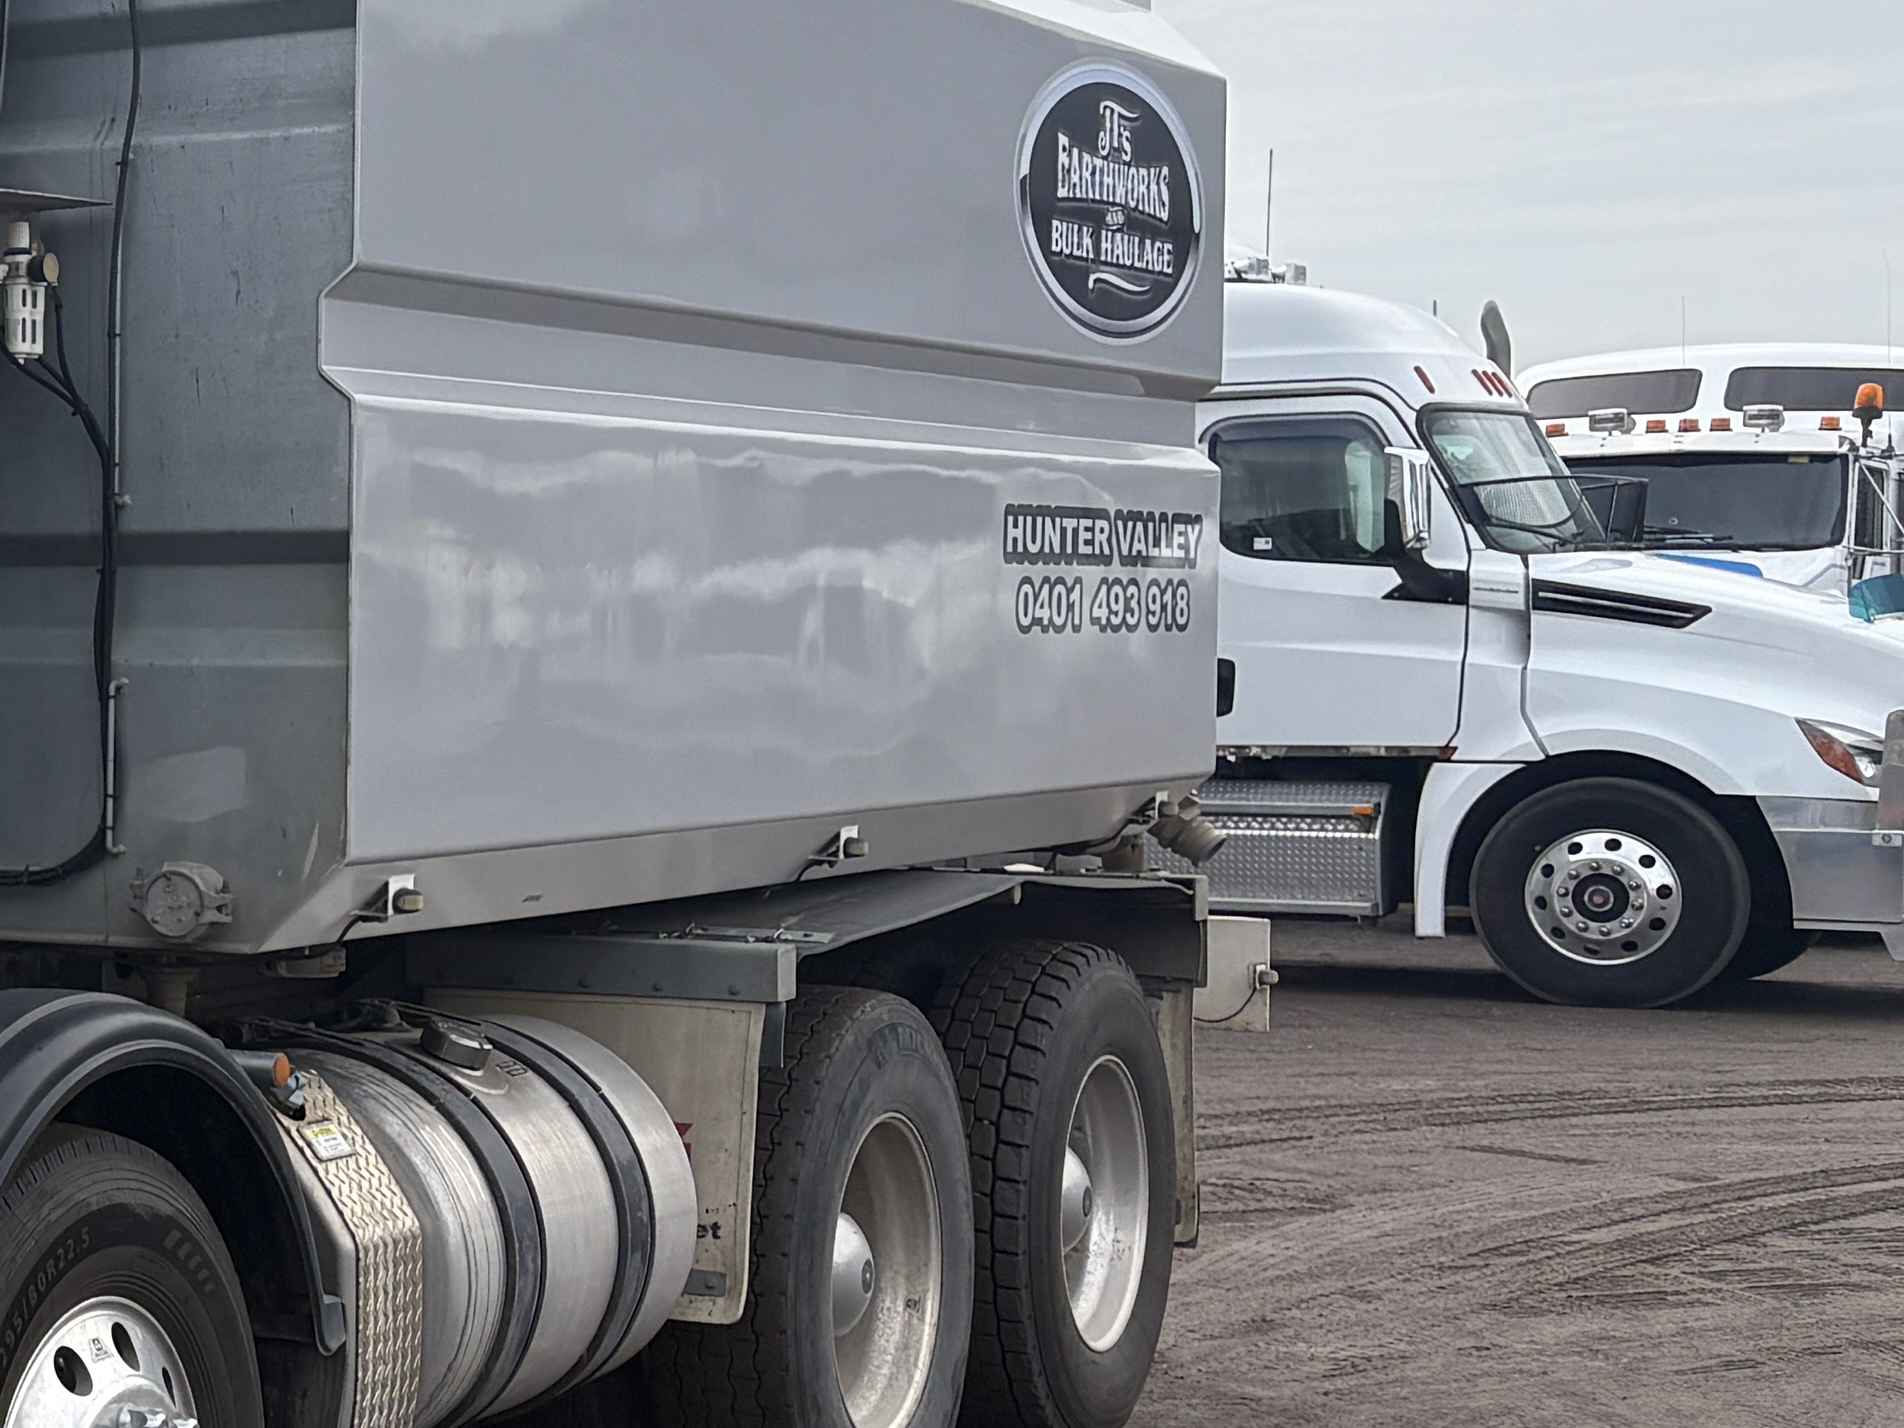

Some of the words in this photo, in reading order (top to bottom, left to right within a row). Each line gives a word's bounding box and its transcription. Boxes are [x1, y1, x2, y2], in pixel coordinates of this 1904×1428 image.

[1056, 132, 1170, 222] EARTHWORKS
[1051, 219, 1095, 259] BULK
[1100, 230, 1174, 274] HAULAGE
[1005, 514, 1111, 557] HUNTER
[1116, 518, 1201, 560] VALLEY
[1017, 581, 1082, 628] 0401
[1092, 582, 1140, 627] 493
[1147, 583, 1190, 627] 918
